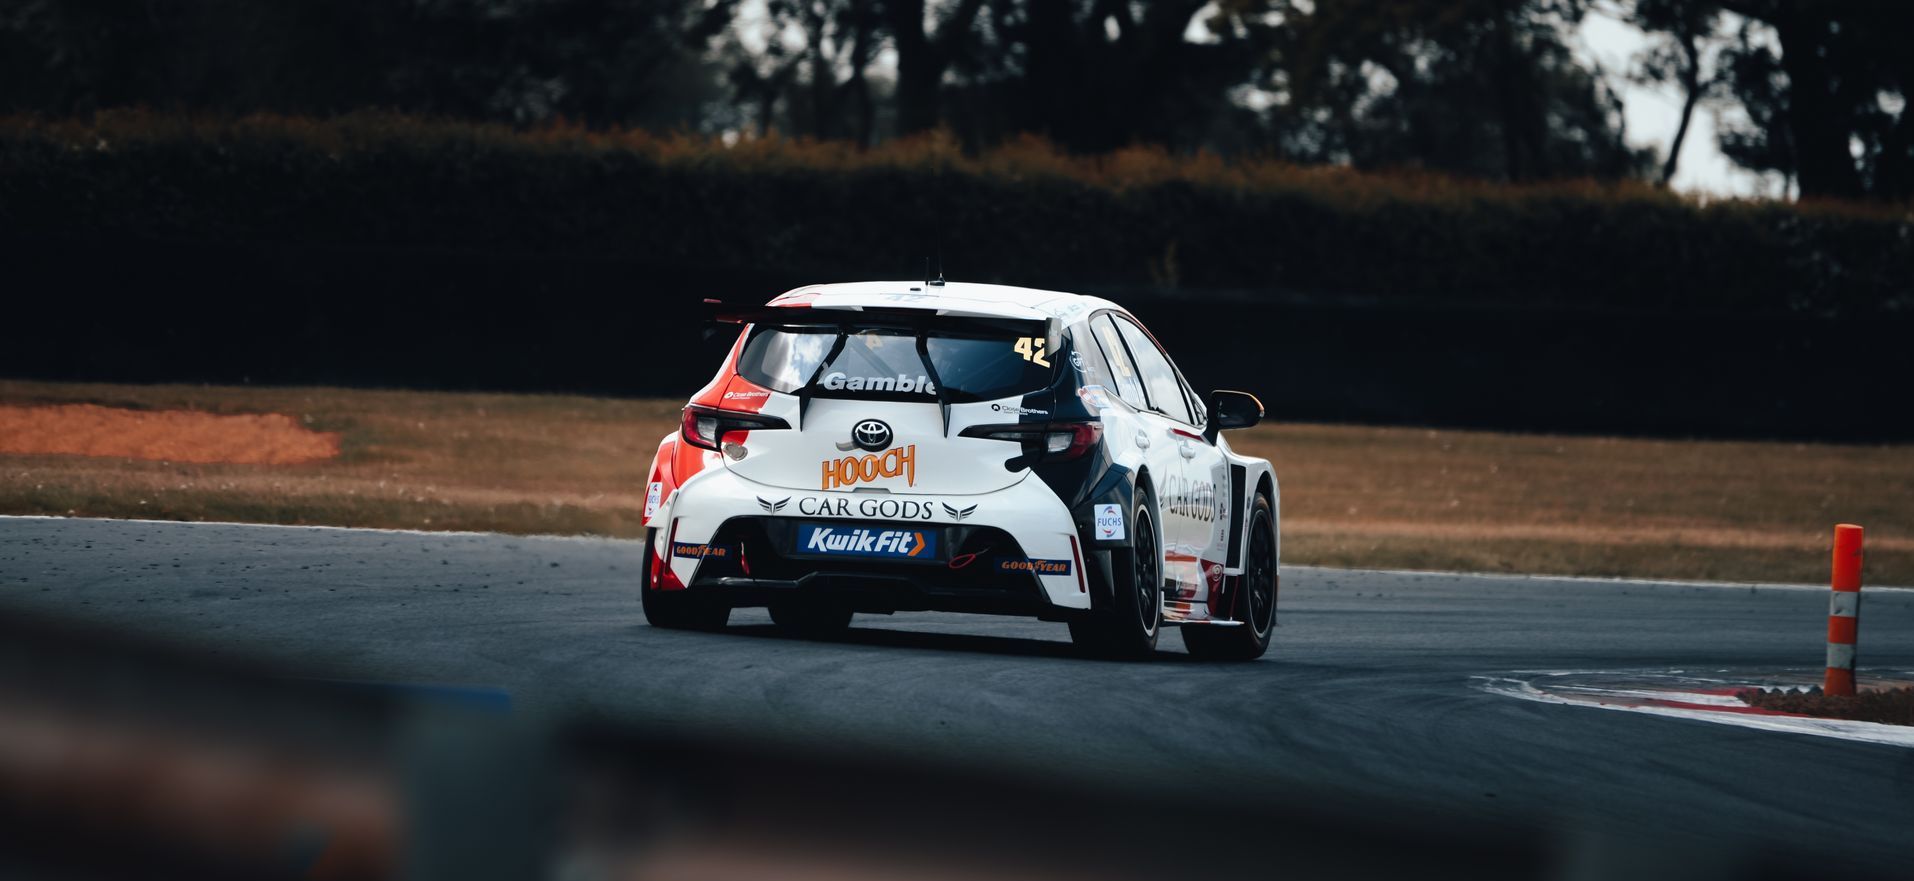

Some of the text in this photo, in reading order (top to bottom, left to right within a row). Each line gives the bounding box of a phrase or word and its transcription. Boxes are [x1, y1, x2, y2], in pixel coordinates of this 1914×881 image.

[1014, 337, 1051, 368] 42
[1020, 407, 1049, 415] Brothers
[821, 444, 916, 490] HOOCH
[799, 497, 933, 520] CAR GODS
[1097, 517, 1122, 527] FUCHS
[1001, 560, 1067, 572] GOODYEAR
